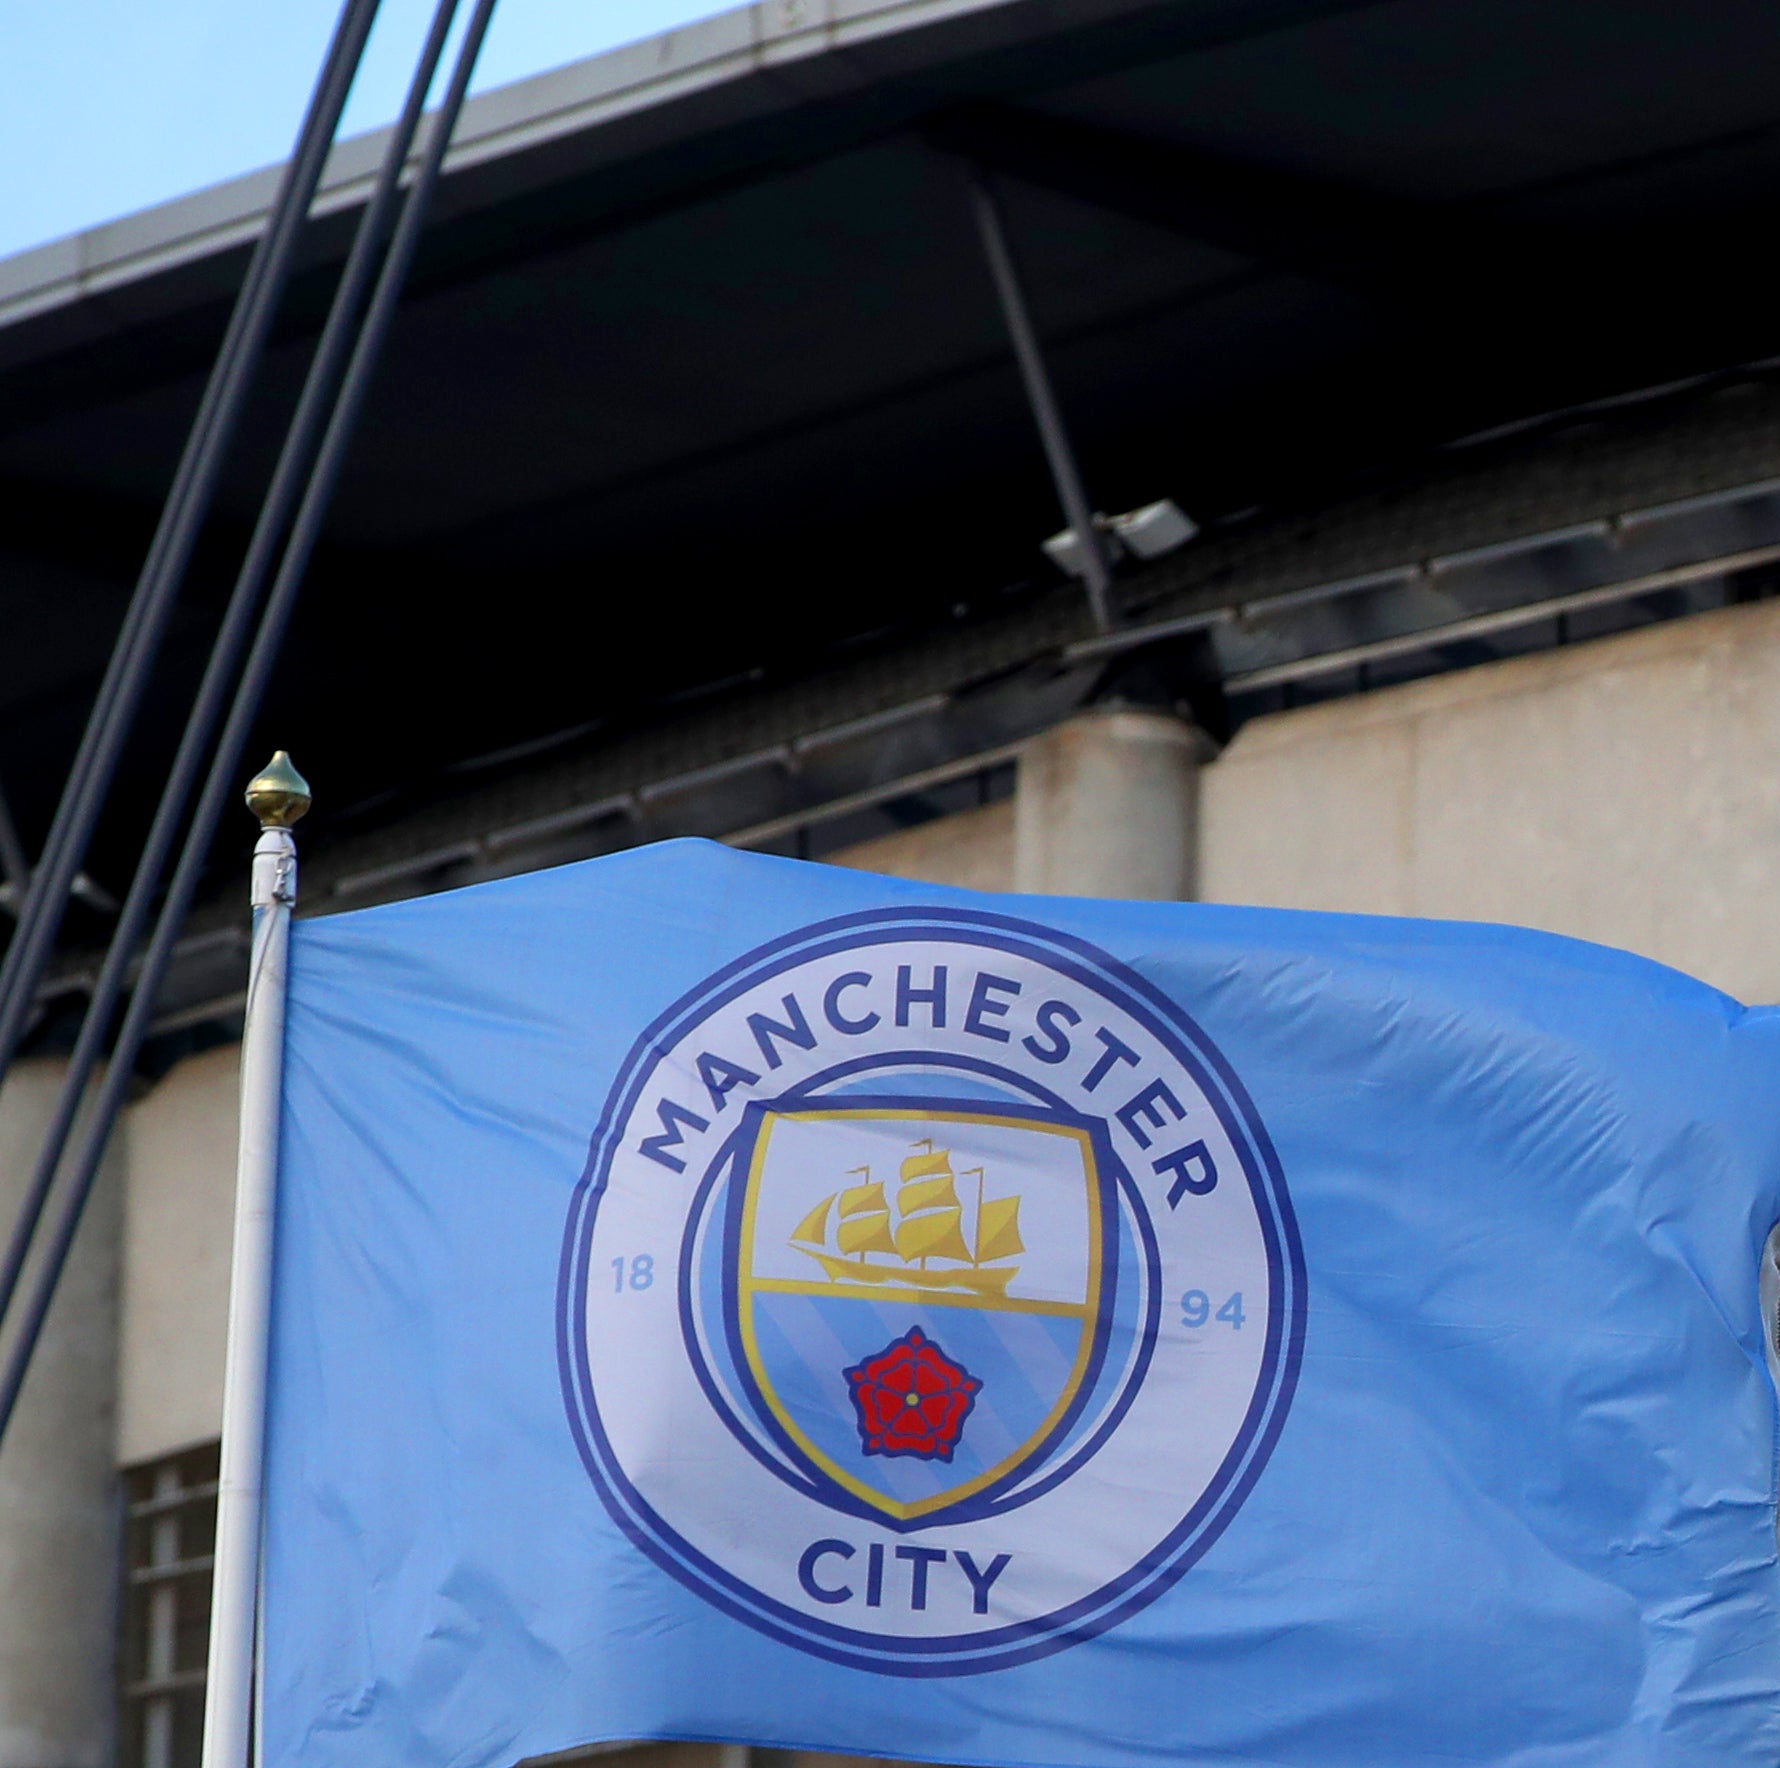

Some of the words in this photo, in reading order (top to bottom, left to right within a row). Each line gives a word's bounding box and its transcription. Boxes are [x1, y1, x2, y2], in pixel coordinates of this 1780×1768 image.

[638, 964, 1219, 1212] MANCHESTER
[610, 1253, 654, 1295] 18
[1182, 1289, 1246, 1330] 94
[797, 1537, 1013, 1614] CITY
